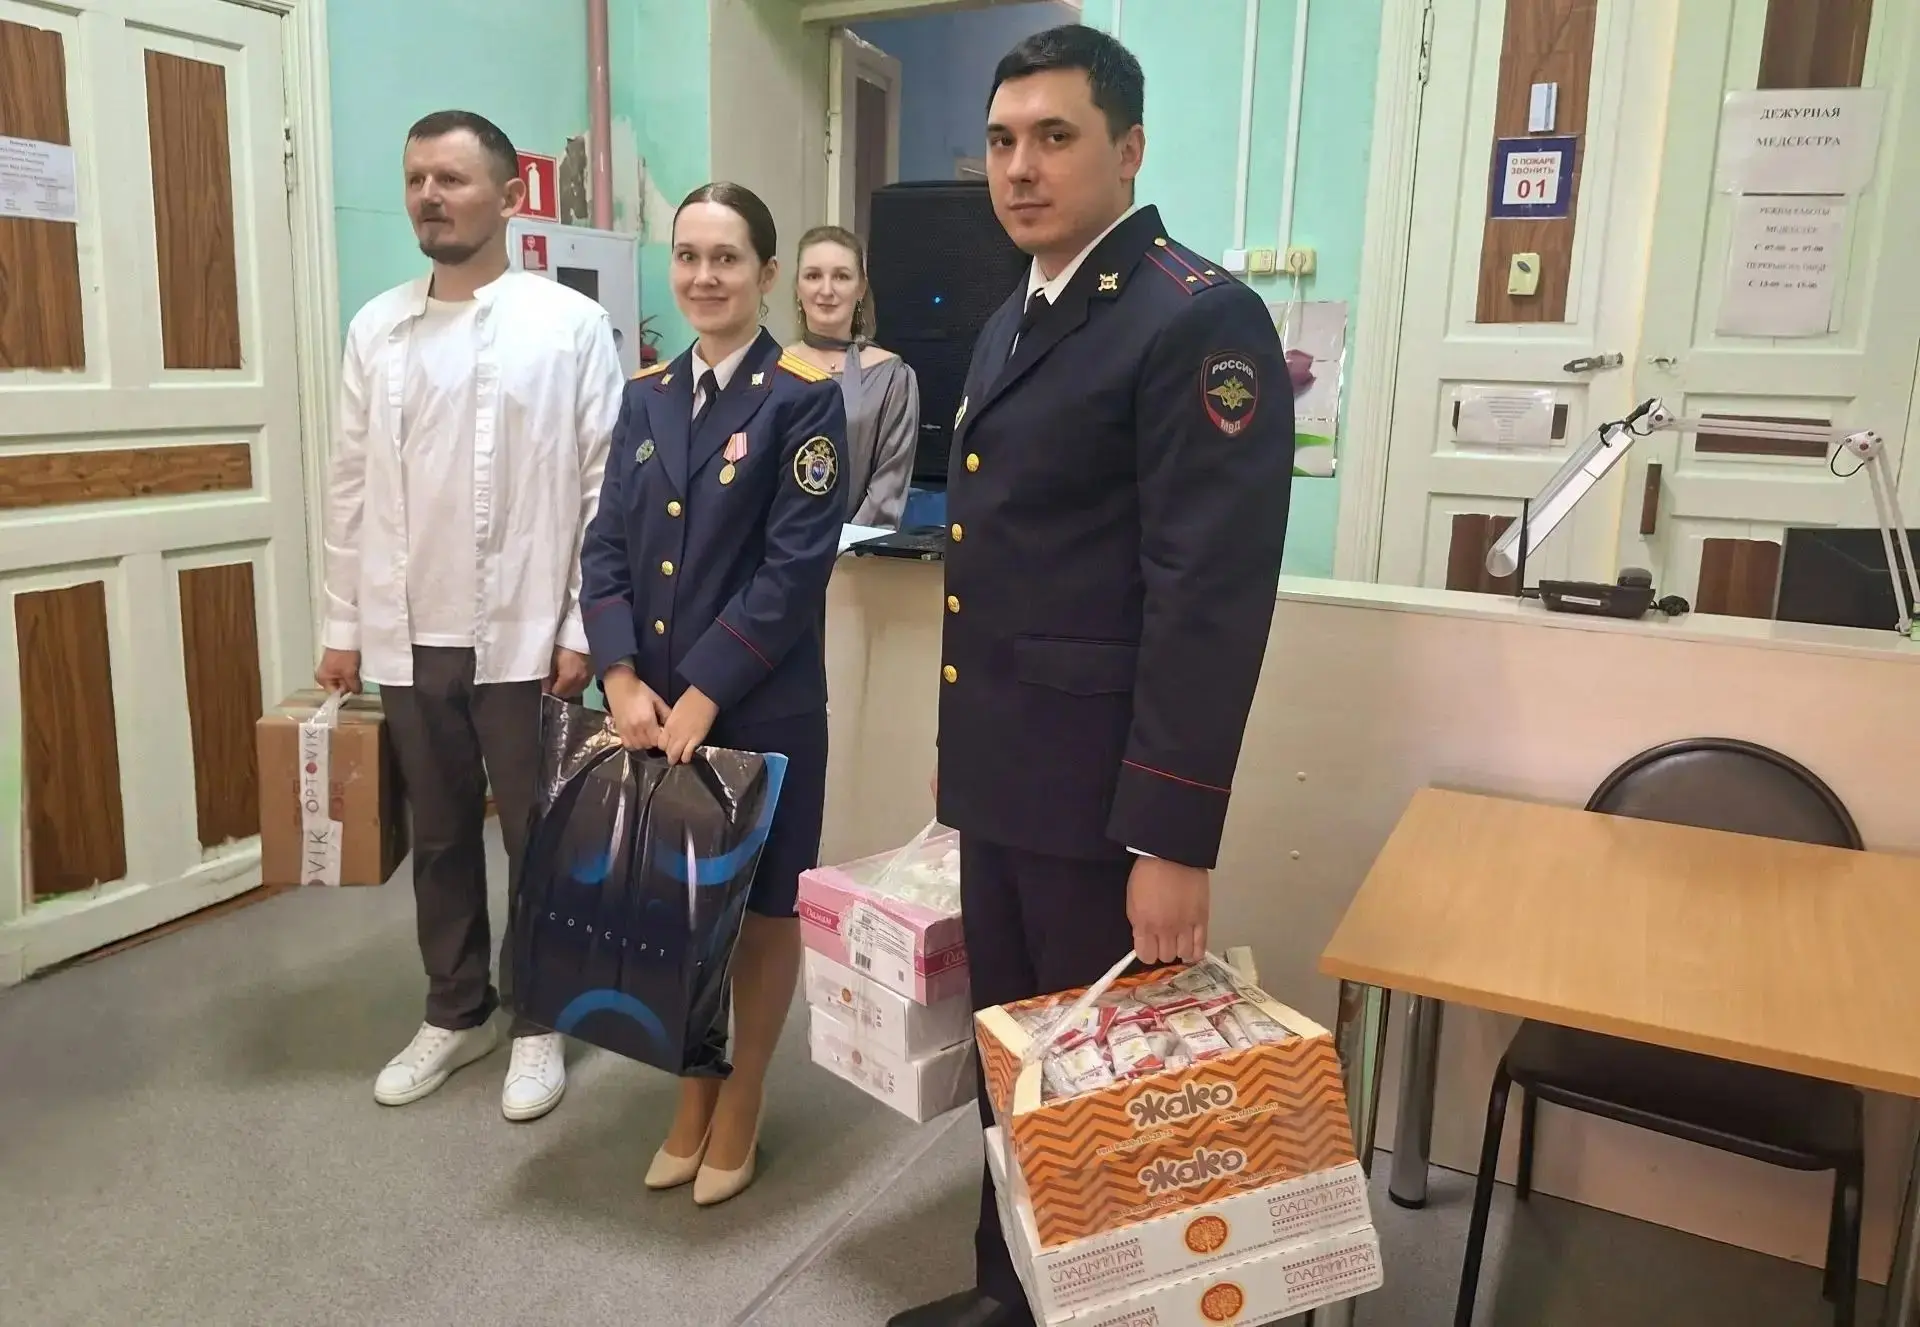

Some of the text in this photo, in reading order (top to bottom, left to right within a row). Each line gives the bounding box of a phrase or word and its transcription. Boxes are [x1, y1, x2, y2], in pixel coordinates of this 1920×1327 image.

[1760, 108, 1841, 120] ДЕЖУРНАЯ
[1757, 136, 1841, 147] МЕДСЕСТРА
[1520, 157, 1556, 165] ПОЖАРЕ
[1511, 167, 1555, 175] ЗВОНИТЬ
[1517, 179, 1546, 199] 01
[1211, 359, 1254, 379] РОССИЯ
[1220, 418, 1240, 434] МВД
